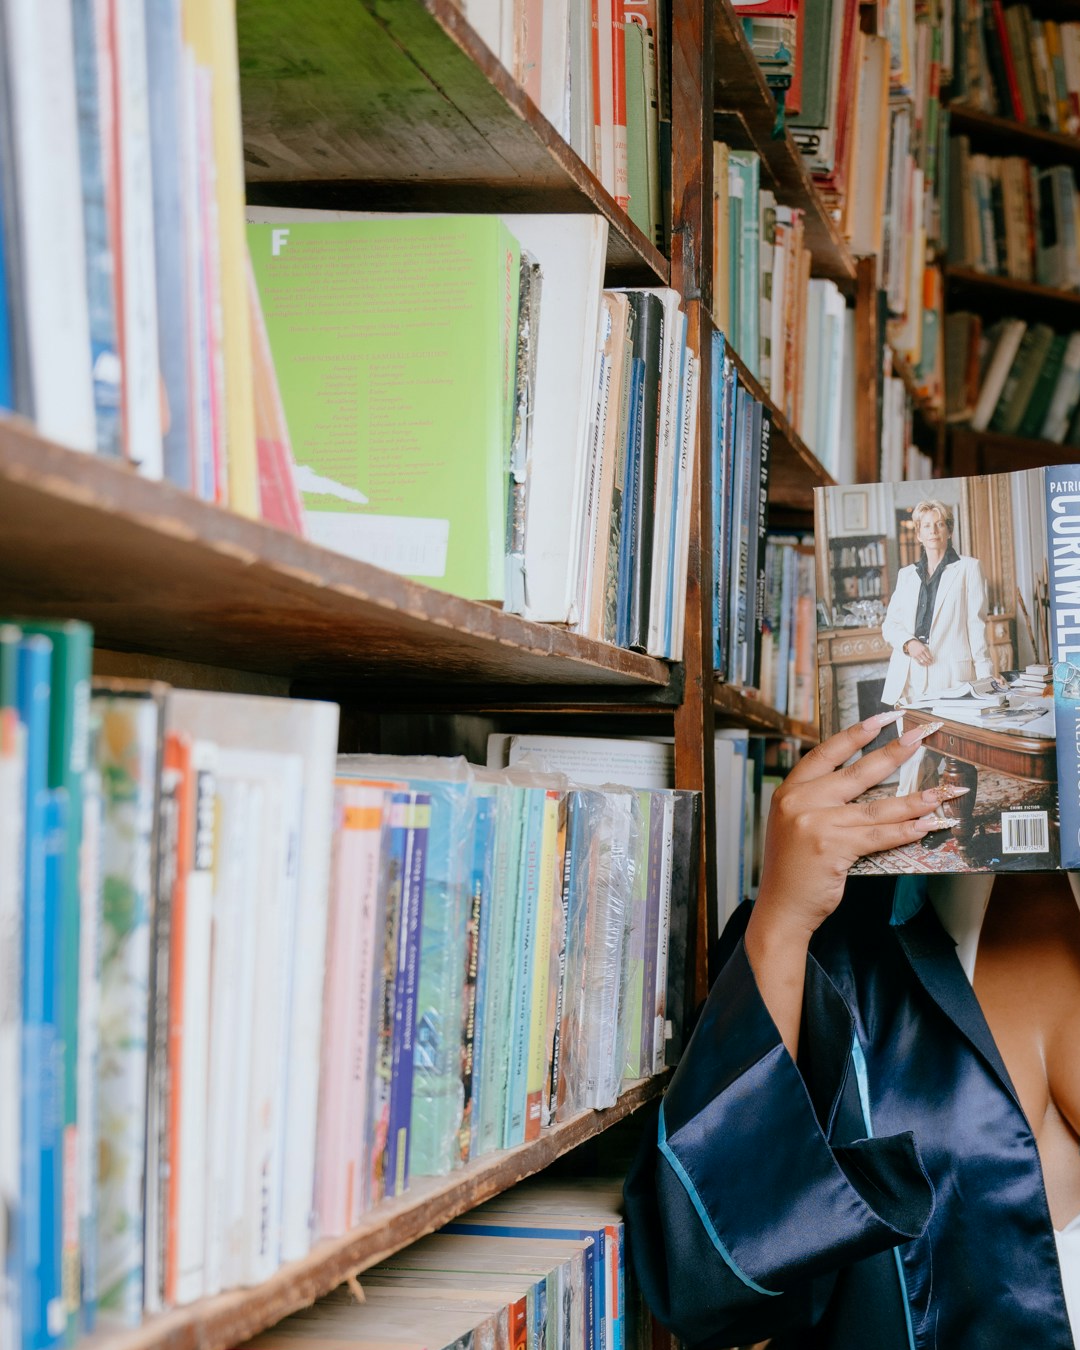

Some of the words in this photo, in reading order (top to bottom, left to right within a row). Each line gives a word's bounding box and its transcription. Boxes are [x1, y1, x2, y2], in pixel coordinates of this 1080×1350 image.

[761, 417, 770, 462] Skin
[760, 467, 769, 484] It
[758, 487, 767, 539] Back
[740, 540, 748, 600] POWER
[738, 607, 747, 646] PLAY
[757, 569, 766, 633] Alexander
[552, 1035, 560, 1086] JEFFREY
